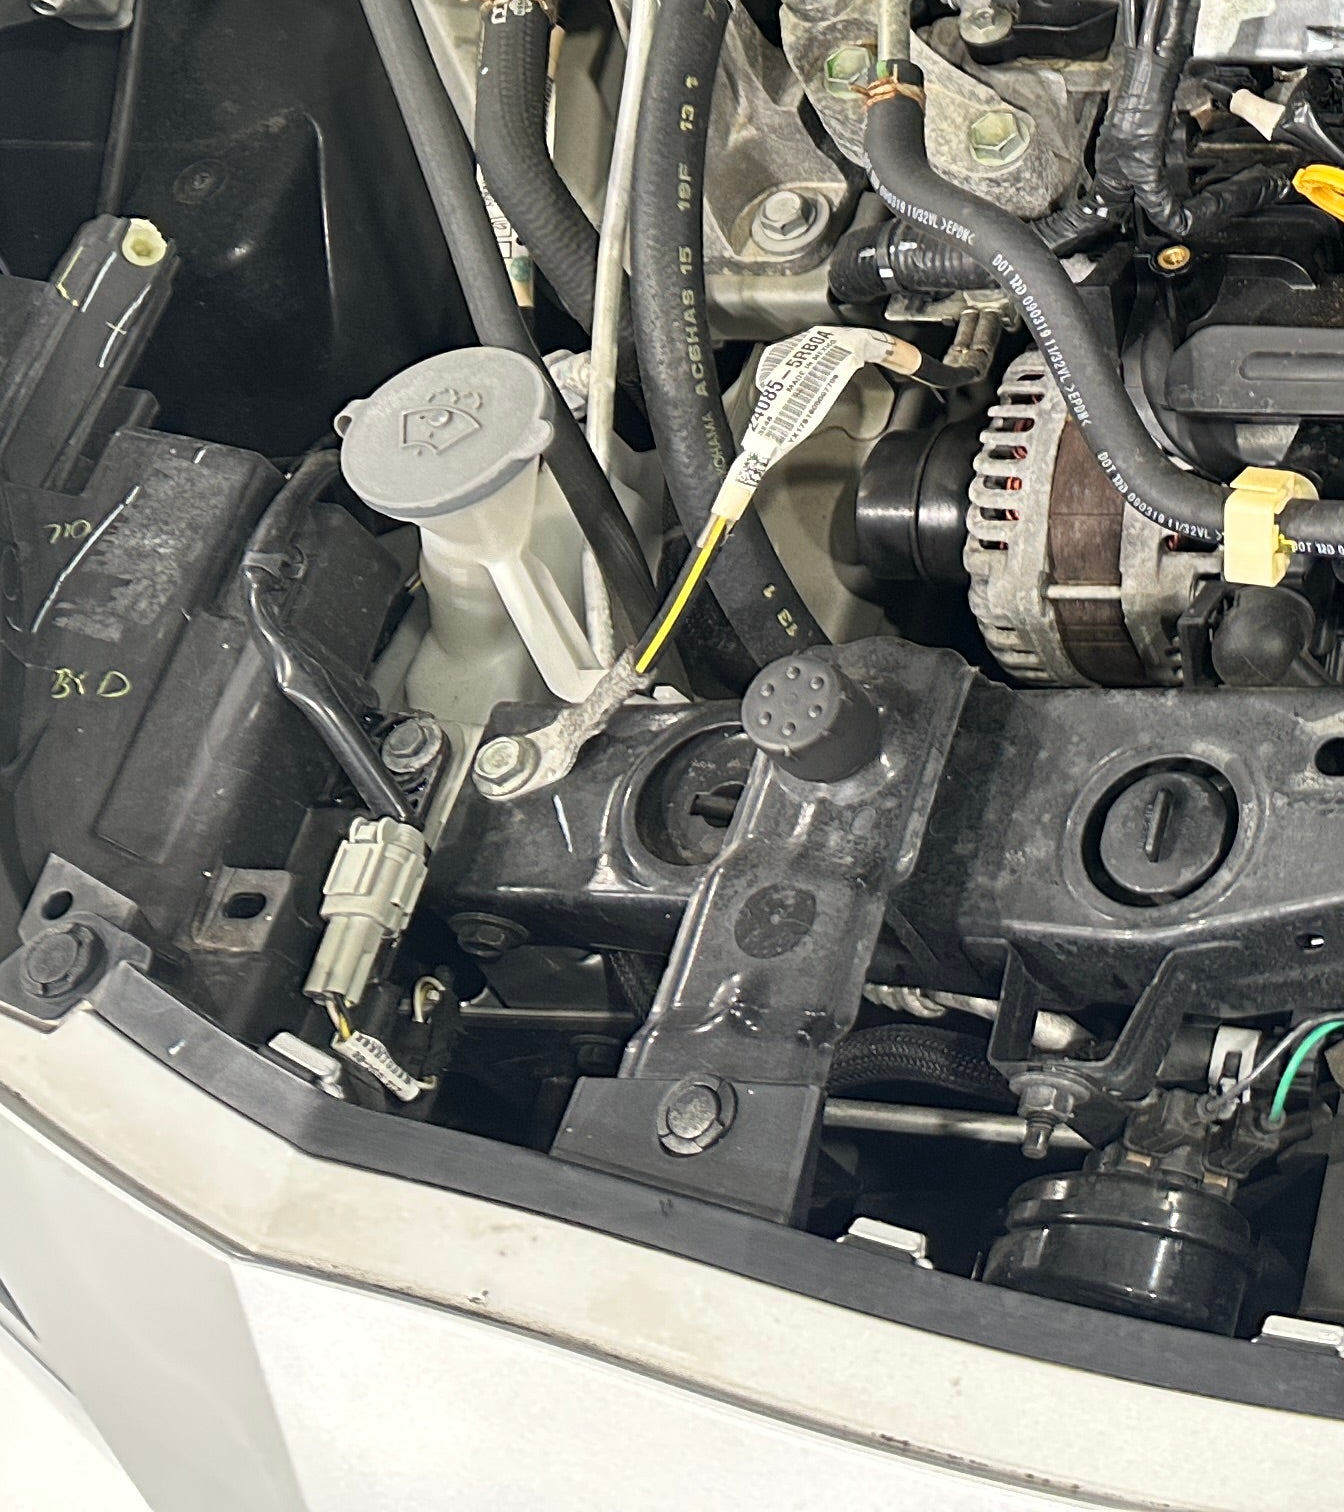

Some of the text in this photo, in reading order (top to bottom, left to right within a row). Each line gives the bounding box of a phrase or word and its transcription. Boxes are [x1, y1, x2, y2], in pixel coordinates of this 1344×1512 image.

[991, 253, 1014, 276] DOT
[1022, 296, 1052, 338] 090319
[1097, 451, 1117, 473] DOT
